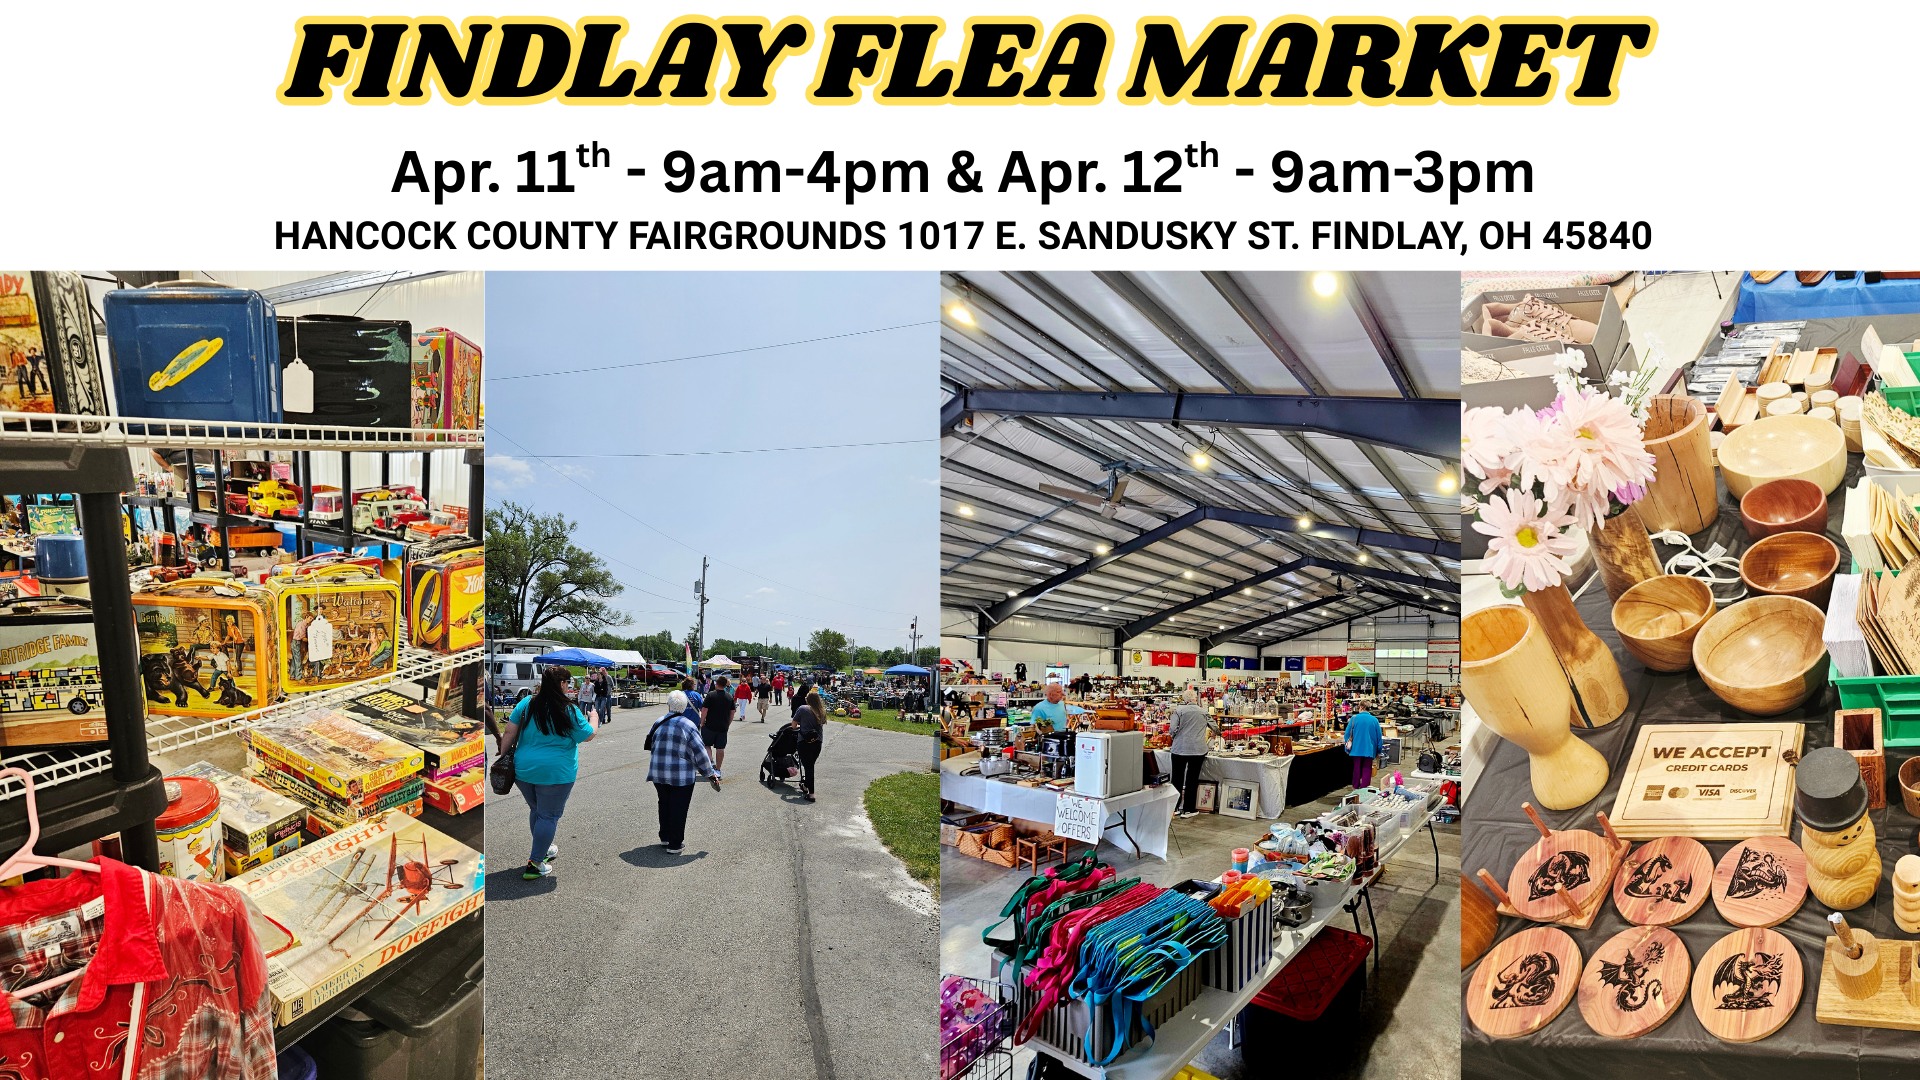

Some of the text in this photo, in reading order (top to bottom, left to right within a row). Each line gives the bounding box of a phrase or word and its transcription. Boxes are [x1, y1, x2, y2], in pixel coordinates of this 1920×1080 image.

[140, 612, 166, 624] Gentle
[52, 634, 89, 651] FAMILY
[451, 747, 468, 763] JAMES
[1653, 745, 1772, 759] WE ACCEPT
[1665, 764, 1748, 772] CREDIT CARDS
[262, 765, 290, 785] ANNIE
[290, 779, 324, 804] OAKLEY
[1698, 788, 1721, 797] VISA
[379, 791, 407, 808] OAKLEY
[1071, 797, 1083, 809] WE
[1056, 805, 1098, 826] WELCOME
[1061, 822, 1092, 840] OFFERS
[246, 821, 388, 894] DOGFIGHT
[252, 848, 309, 878] AMERICAN
[312, 824, 364, 851] HERITAGE
[313, 961, 366, 998] AMERICAN
[313, 970, 366, 1007] HERITAGE
